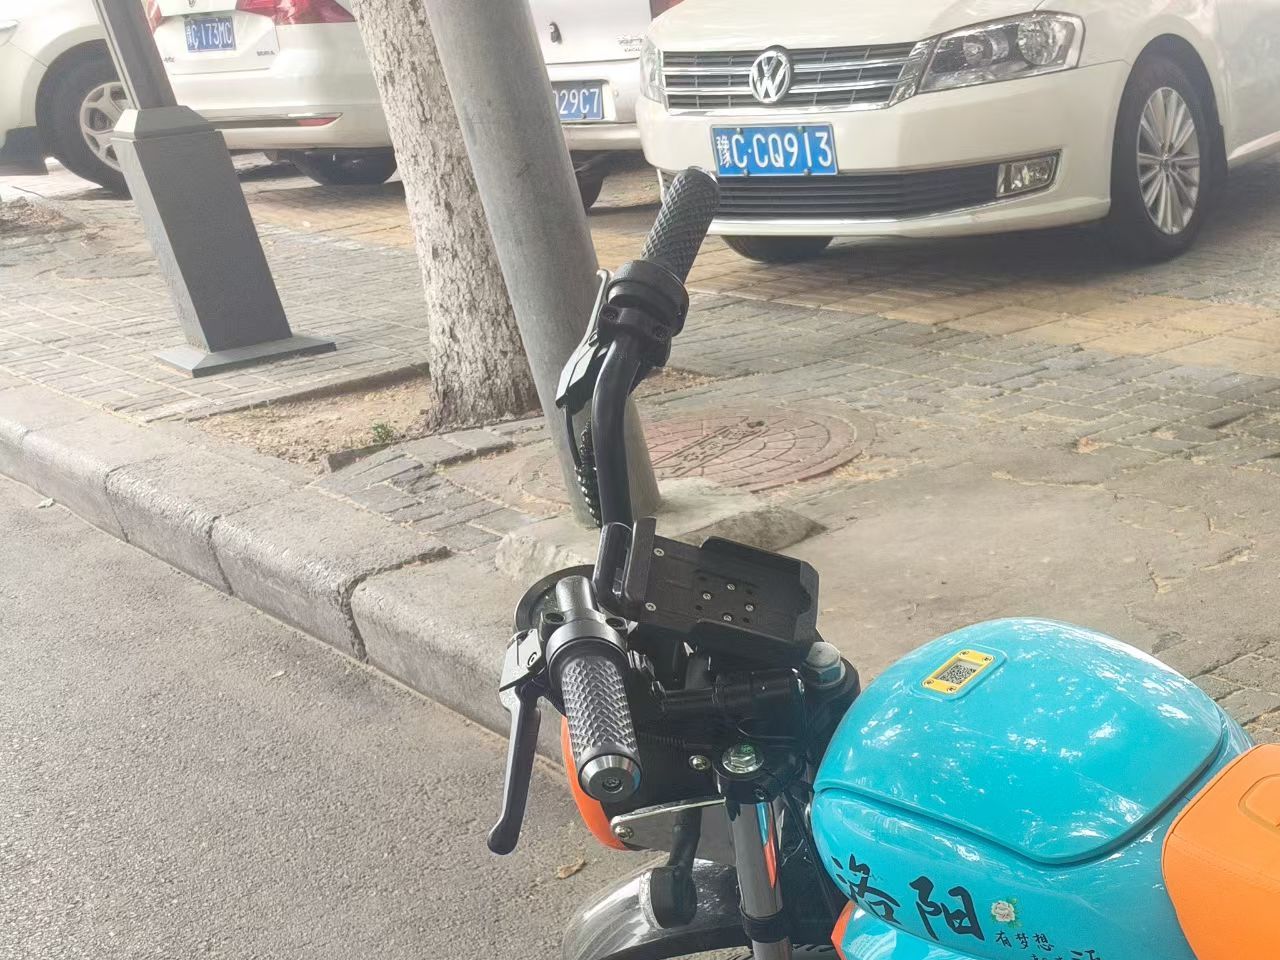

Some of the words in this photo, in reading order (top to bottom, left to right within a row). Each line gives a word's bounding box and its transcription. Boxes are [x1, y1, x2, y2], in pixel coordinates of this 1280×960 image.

[830, 853, 985, 942] 洛阳
[995, 930, 1055, 952] 有梦想
